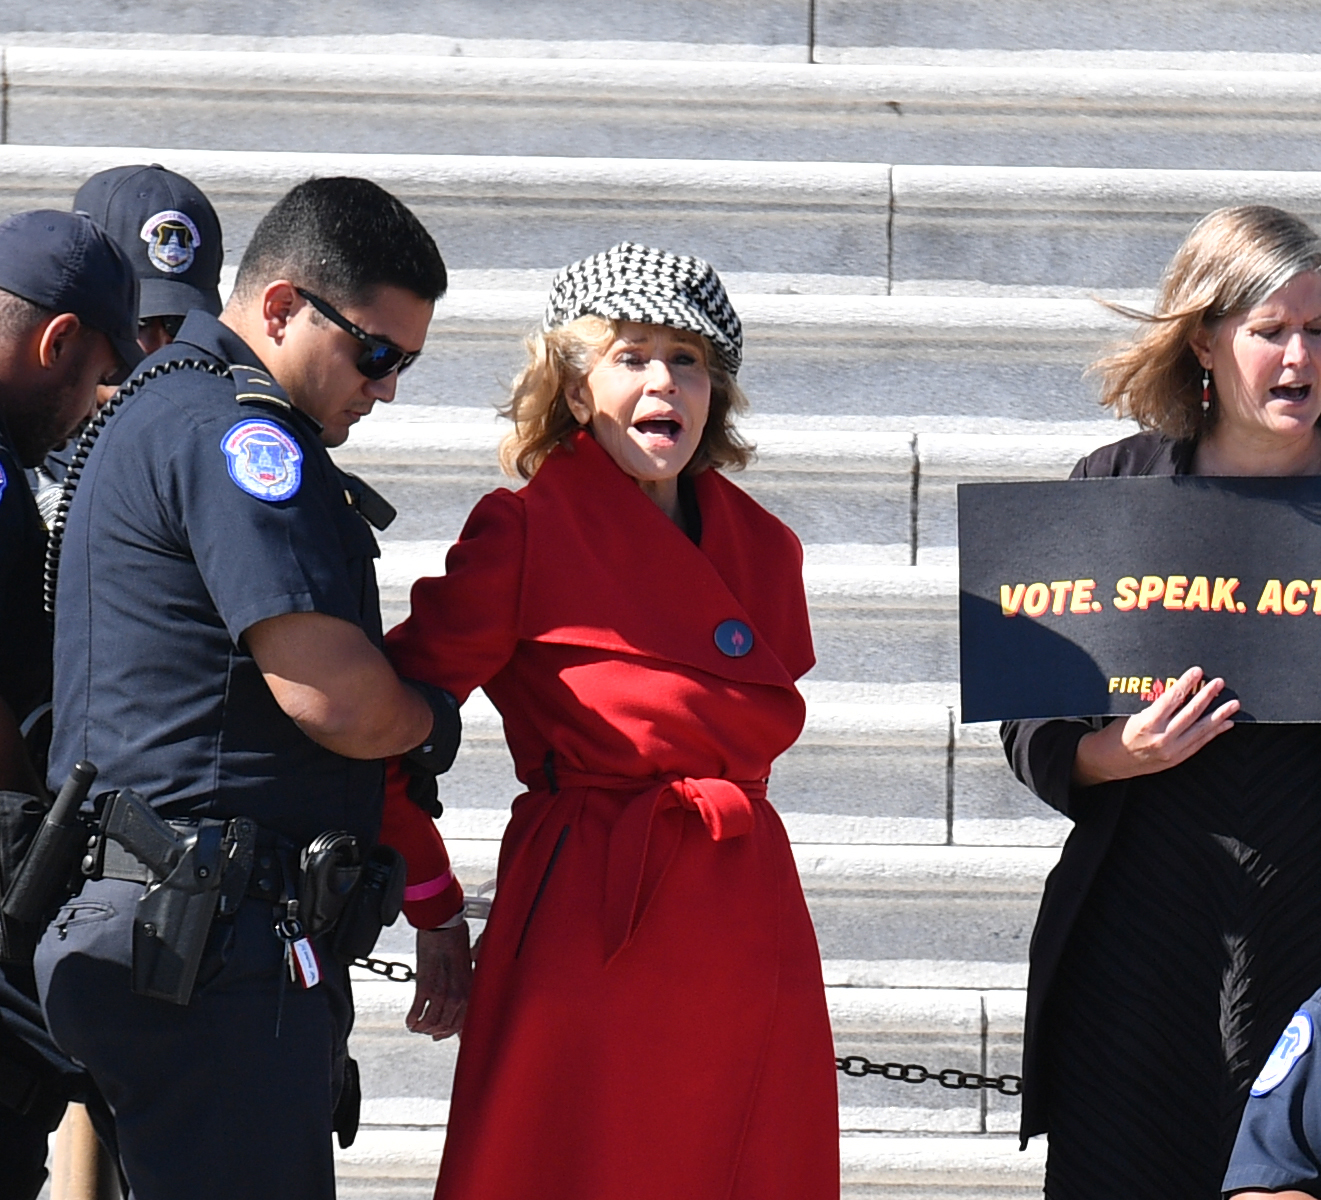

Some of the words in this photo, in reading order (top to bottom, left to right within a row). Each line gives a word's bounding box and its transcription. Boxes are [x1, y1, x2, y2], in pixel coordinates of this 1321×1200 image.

[1000, 578, 1102, 618] VOTE.
[1113, 575, 1247, 614] SPEAK.
[1108, 677, 1153, 694] FIRE
